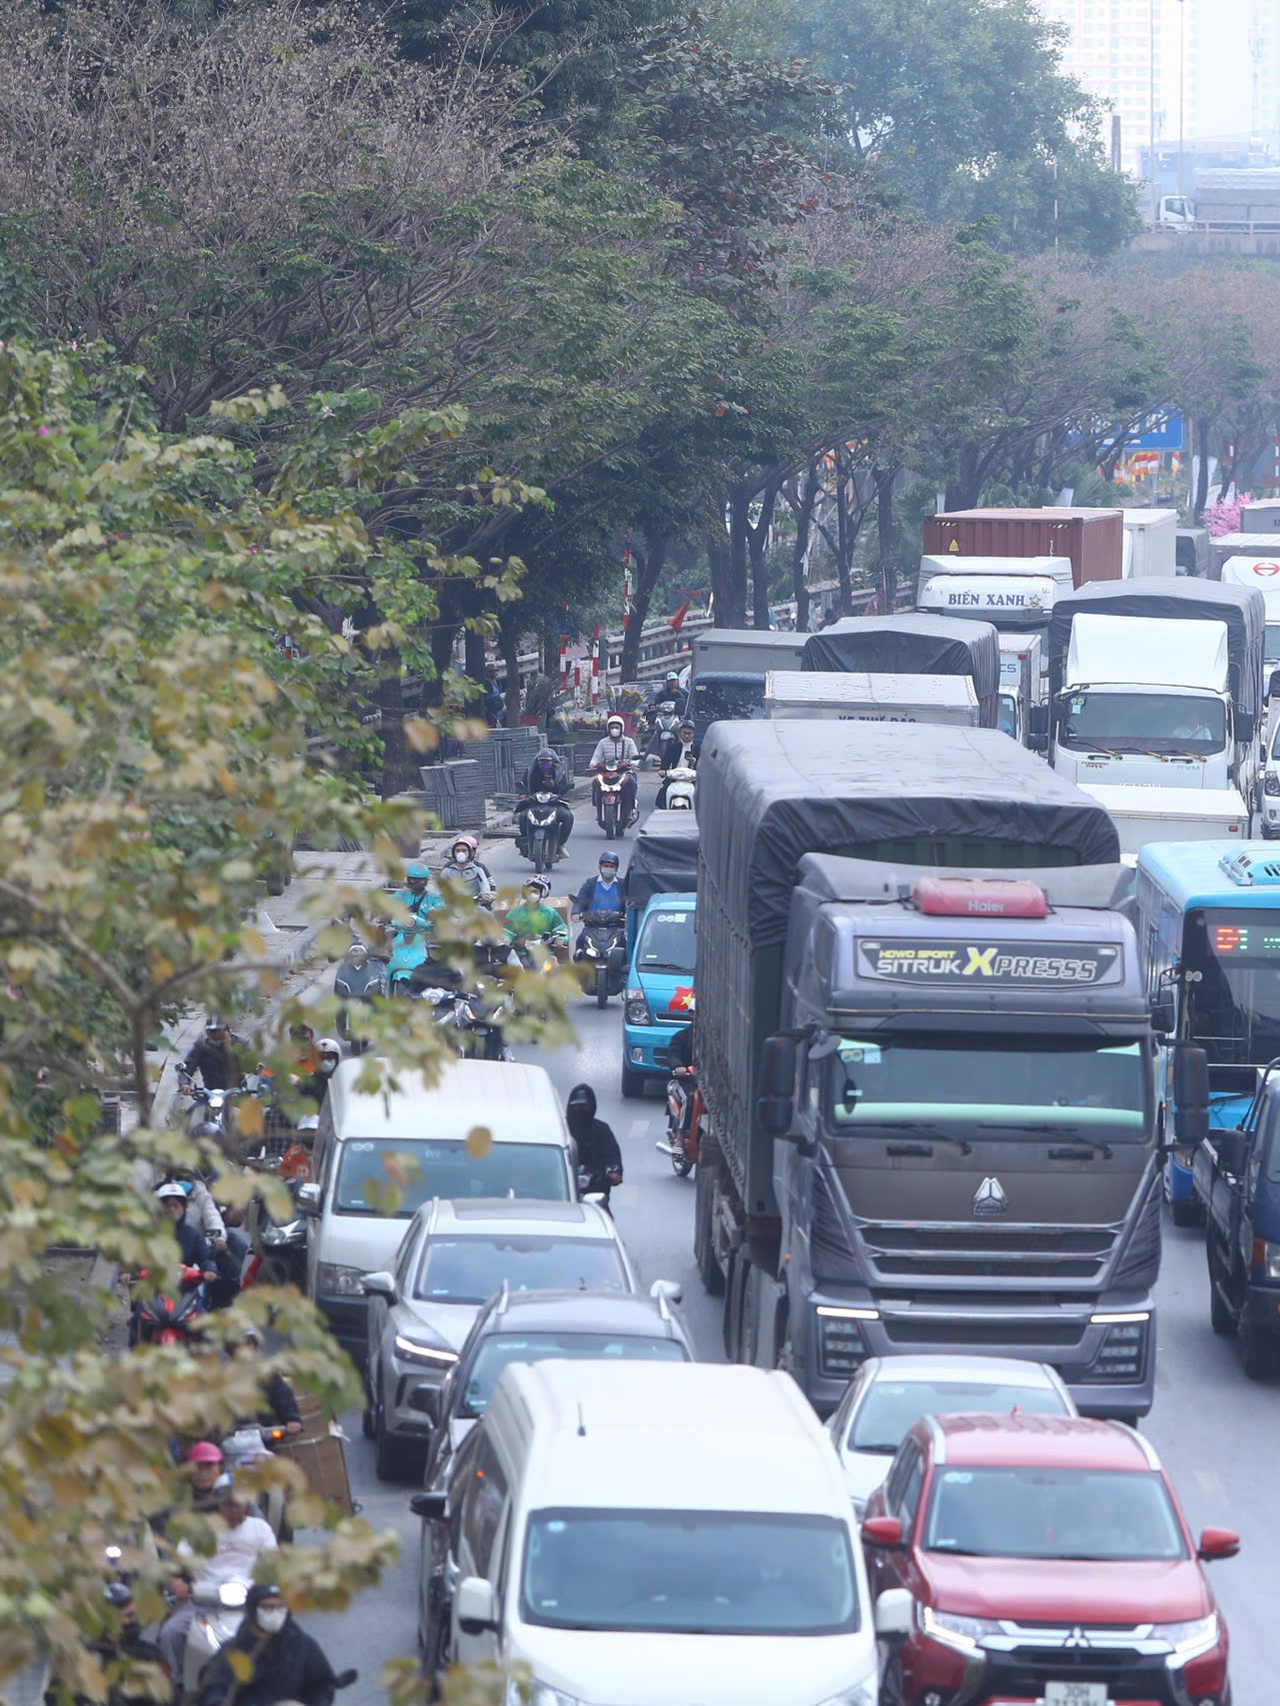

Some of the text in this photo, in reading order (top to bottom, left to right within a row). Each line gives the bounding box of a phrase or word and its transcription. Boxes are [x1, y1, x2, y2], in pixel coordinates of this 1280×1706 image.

[986, 594, 1025, 606] XANH
[968, 901, 1004, 912] Haier
[879, 950, 956, 959] HOWO SPORT
[876, 958, 962, 974] SITRUK
